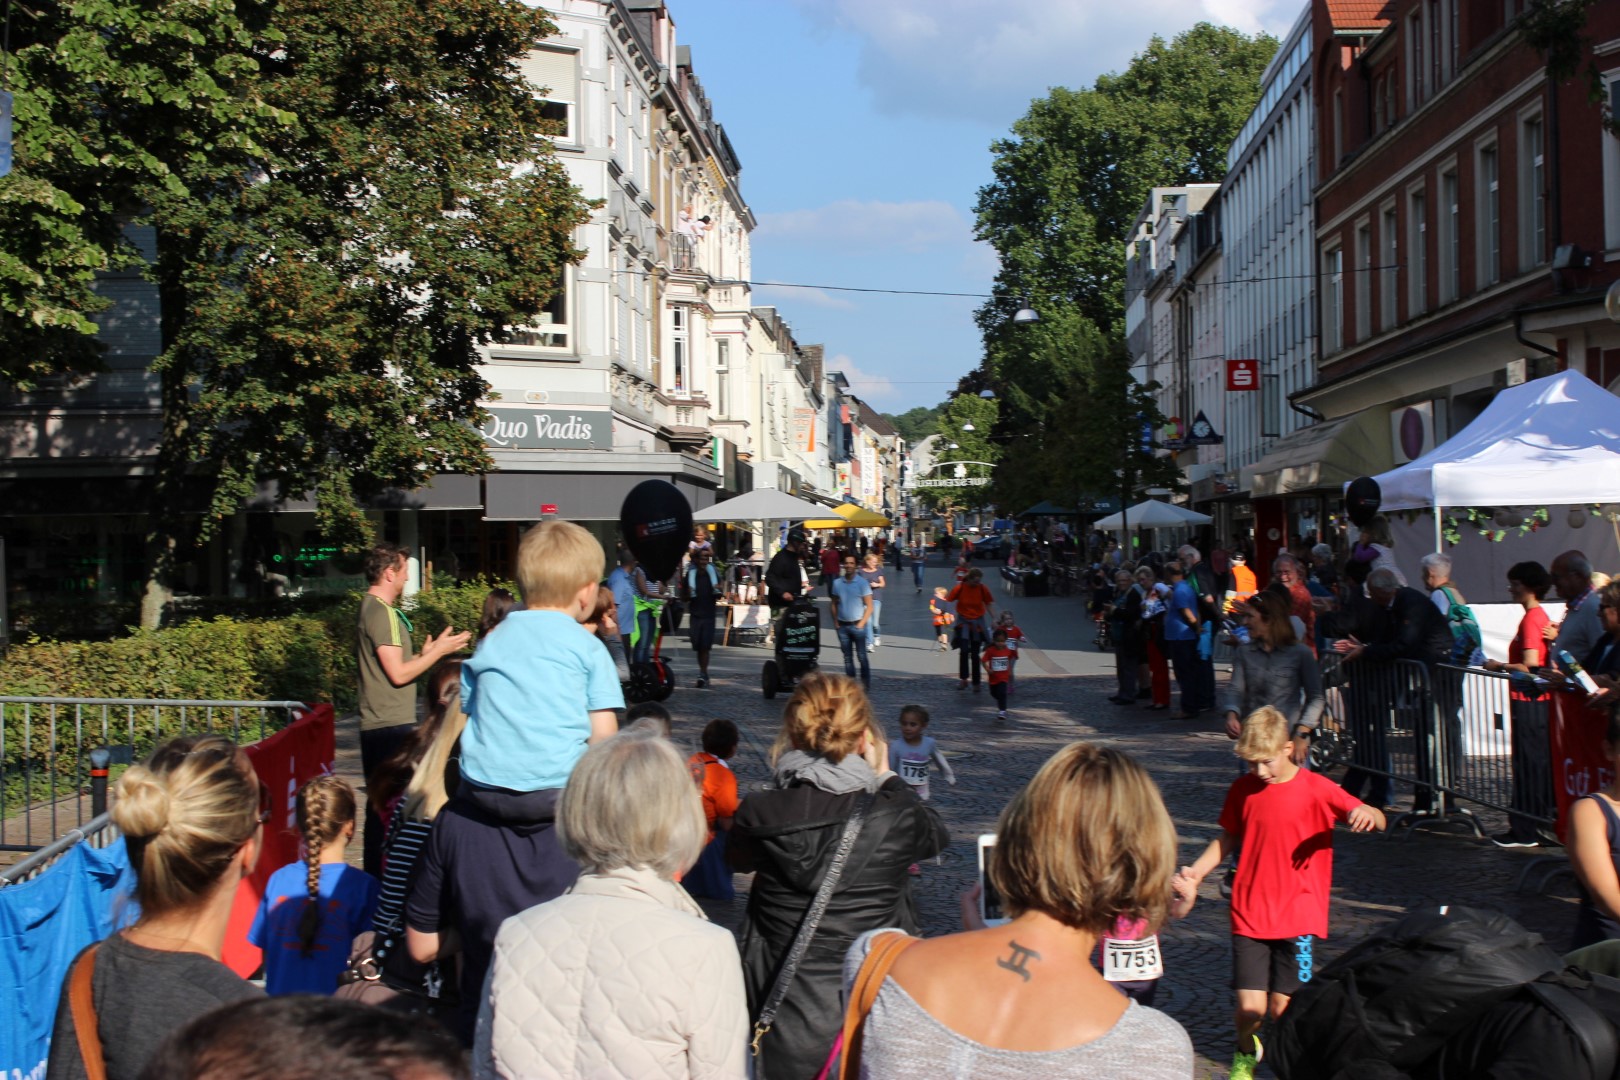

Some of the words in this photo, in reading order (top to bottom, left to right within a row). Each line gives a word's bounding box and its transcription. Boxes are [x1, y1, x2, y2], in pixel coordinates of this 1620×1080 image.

[480, 413, 528, 446] Quo
[533, 414, 592, 440] Vadis
[1110, 948, 1157, 969] 1753
